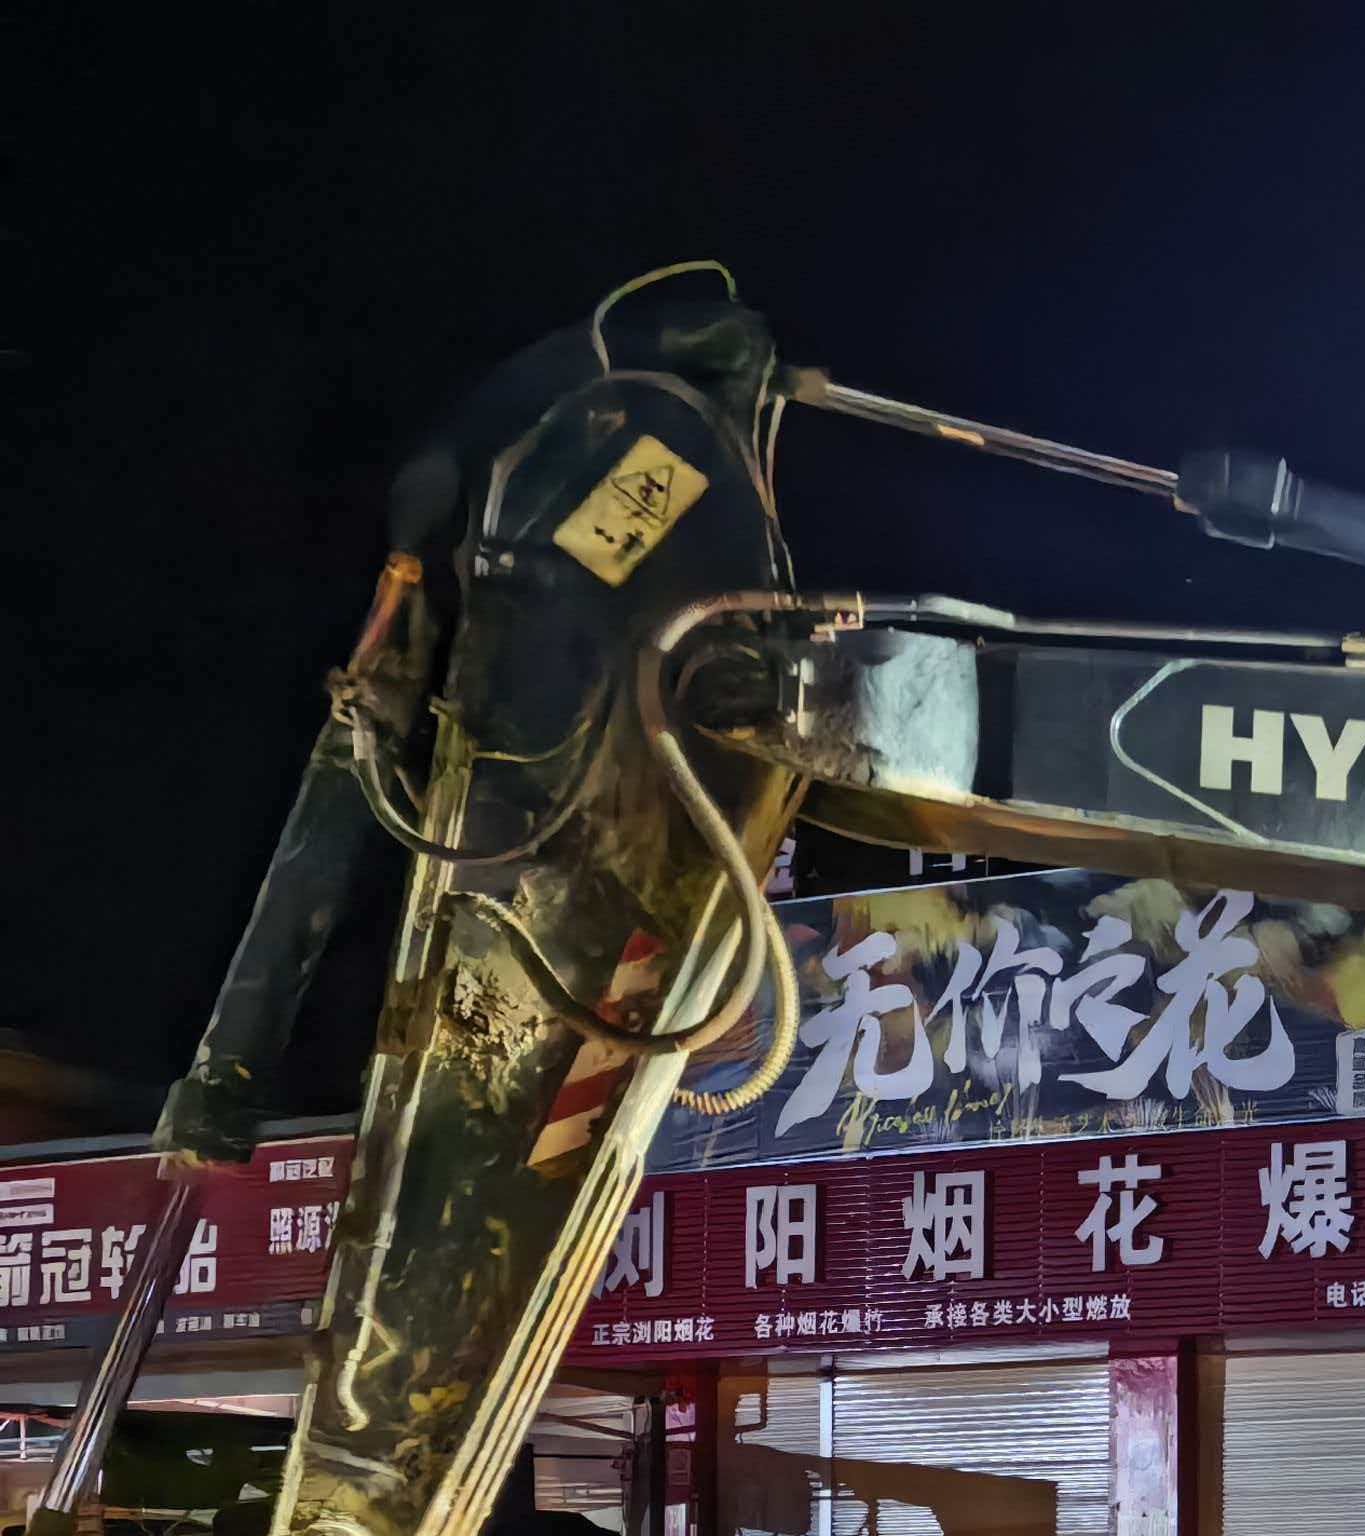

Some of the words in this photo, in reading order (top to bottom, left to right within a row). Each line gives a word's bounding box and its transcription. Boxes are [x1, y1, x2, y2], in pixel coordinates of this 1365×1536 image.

[591, 1315, 716, 1346] 正宗浏阳烟花
[923, 1292, 1132, 1330] 承接各类大小型燃放
